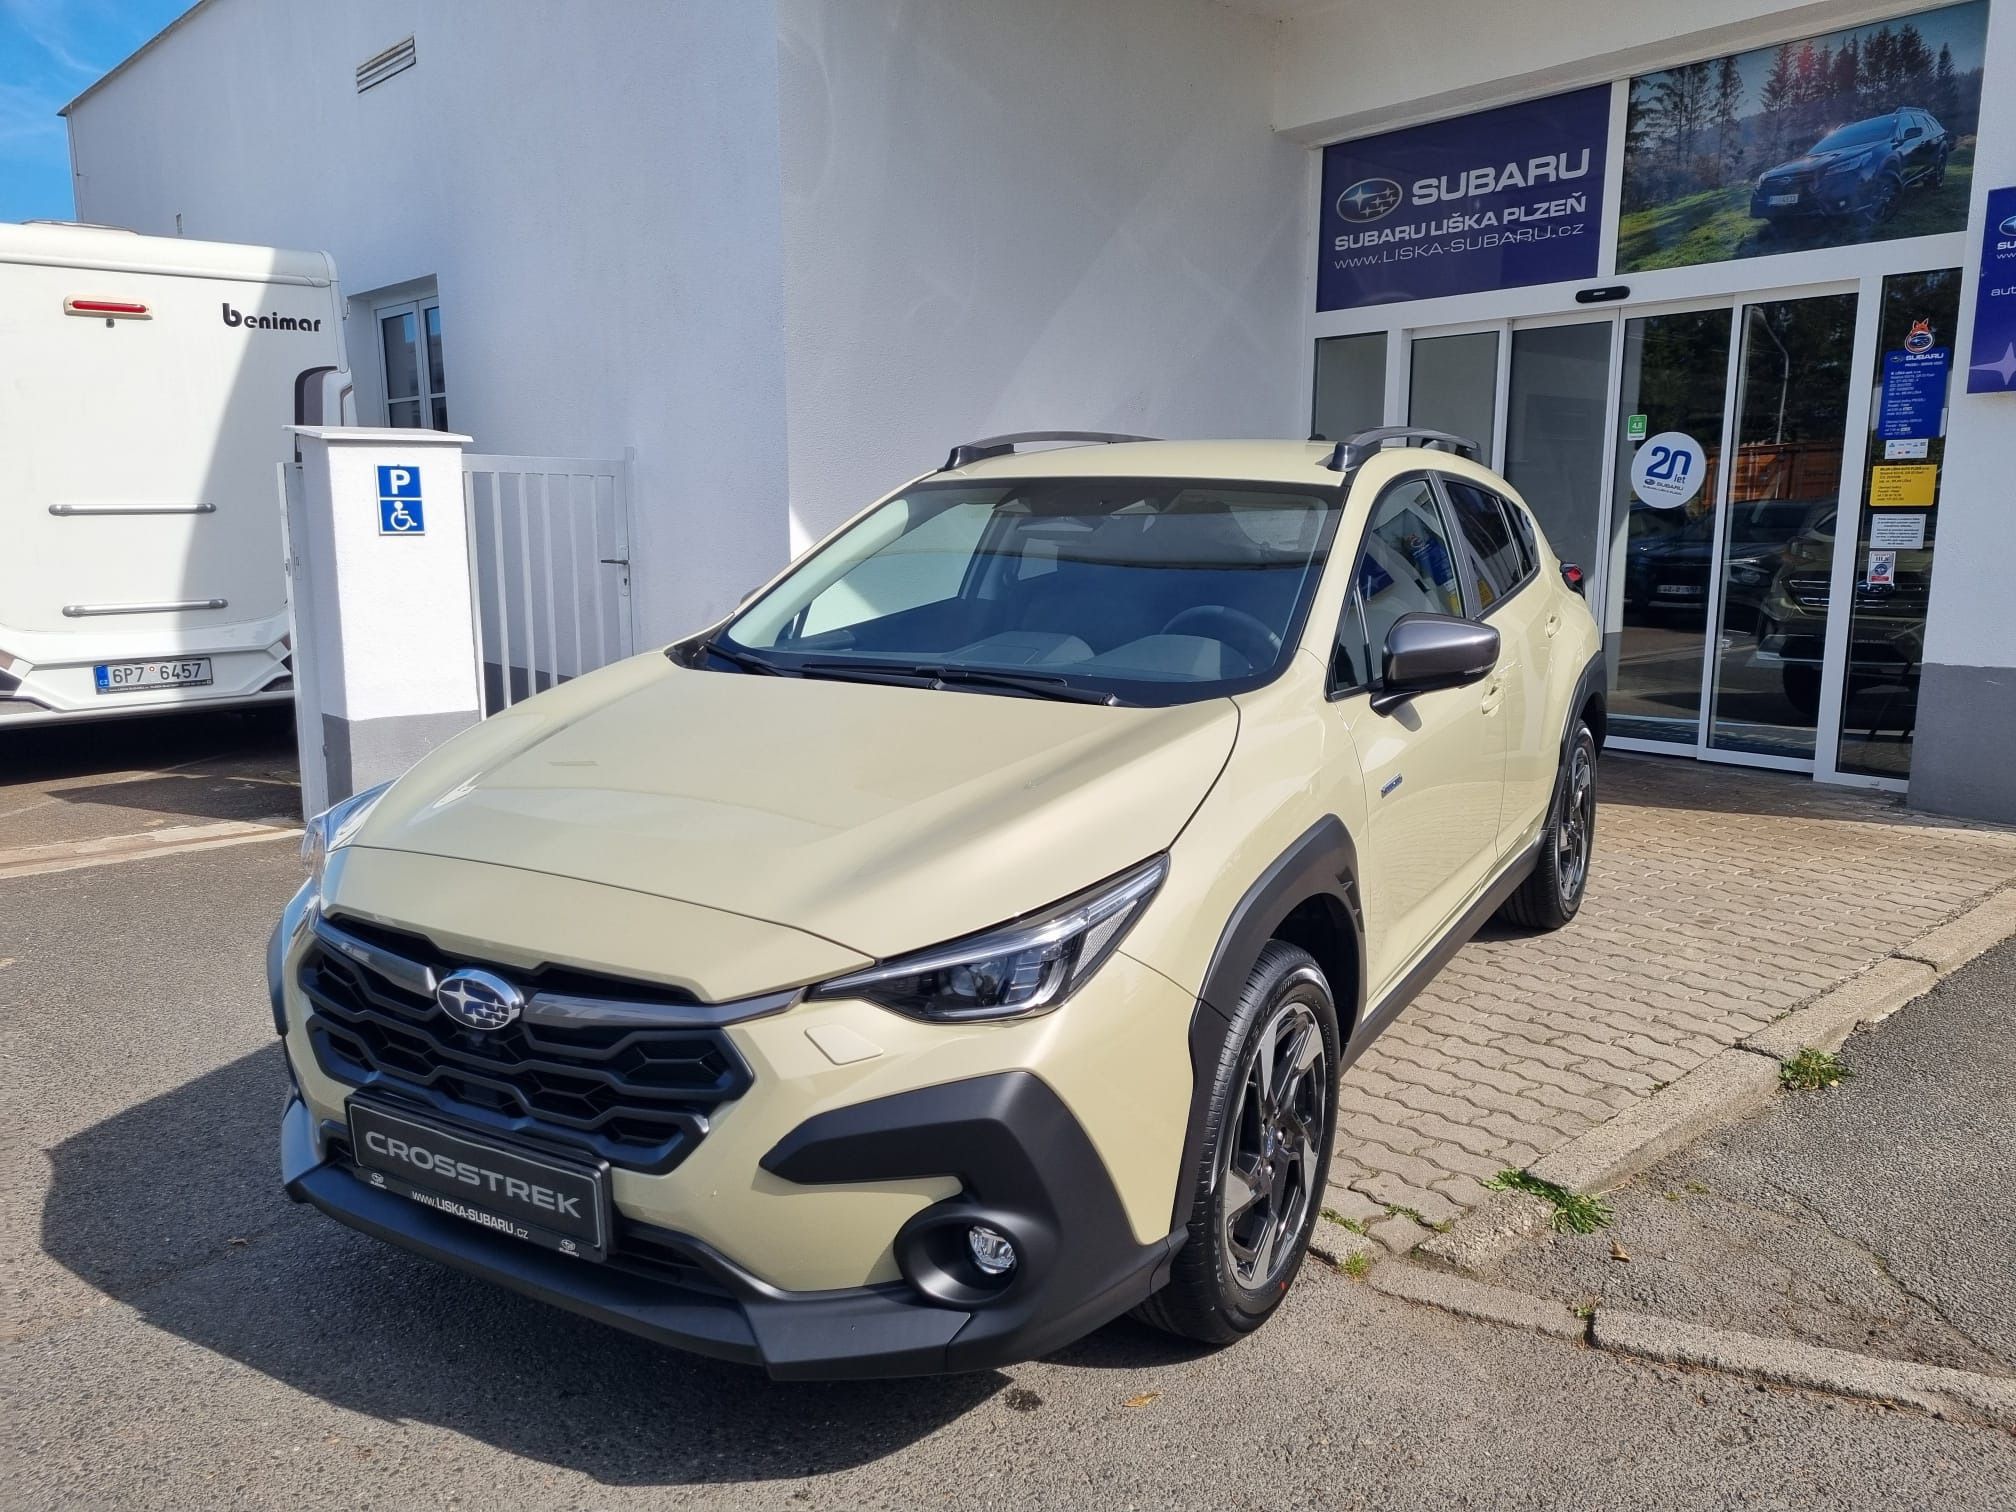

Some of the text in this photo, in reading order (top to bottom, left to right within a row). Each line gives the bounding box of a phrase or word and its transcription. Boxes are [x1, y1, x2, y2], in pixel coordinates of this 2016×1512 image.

[1412, 148, 1590, 206] SUBARU
[1334, 191, 1587, 251] SUBARU LIŠKA PLZEŇ
[1334, 223, 1585, 269] www.LISKA-SUBARU.cz
[222, 302, 322, 332] benimar
[1905, 352, 1944, 361] SUBARU
[390, 469, 411, 495] P
[1673, 473, 1686, 484] let
[112, 662, 202, 684] 6P7 6457
[365, 1131, 582, 1219] CROSSTREK
[411, 1190, 529, 1240] www.LISKA-SUBARU.cz
